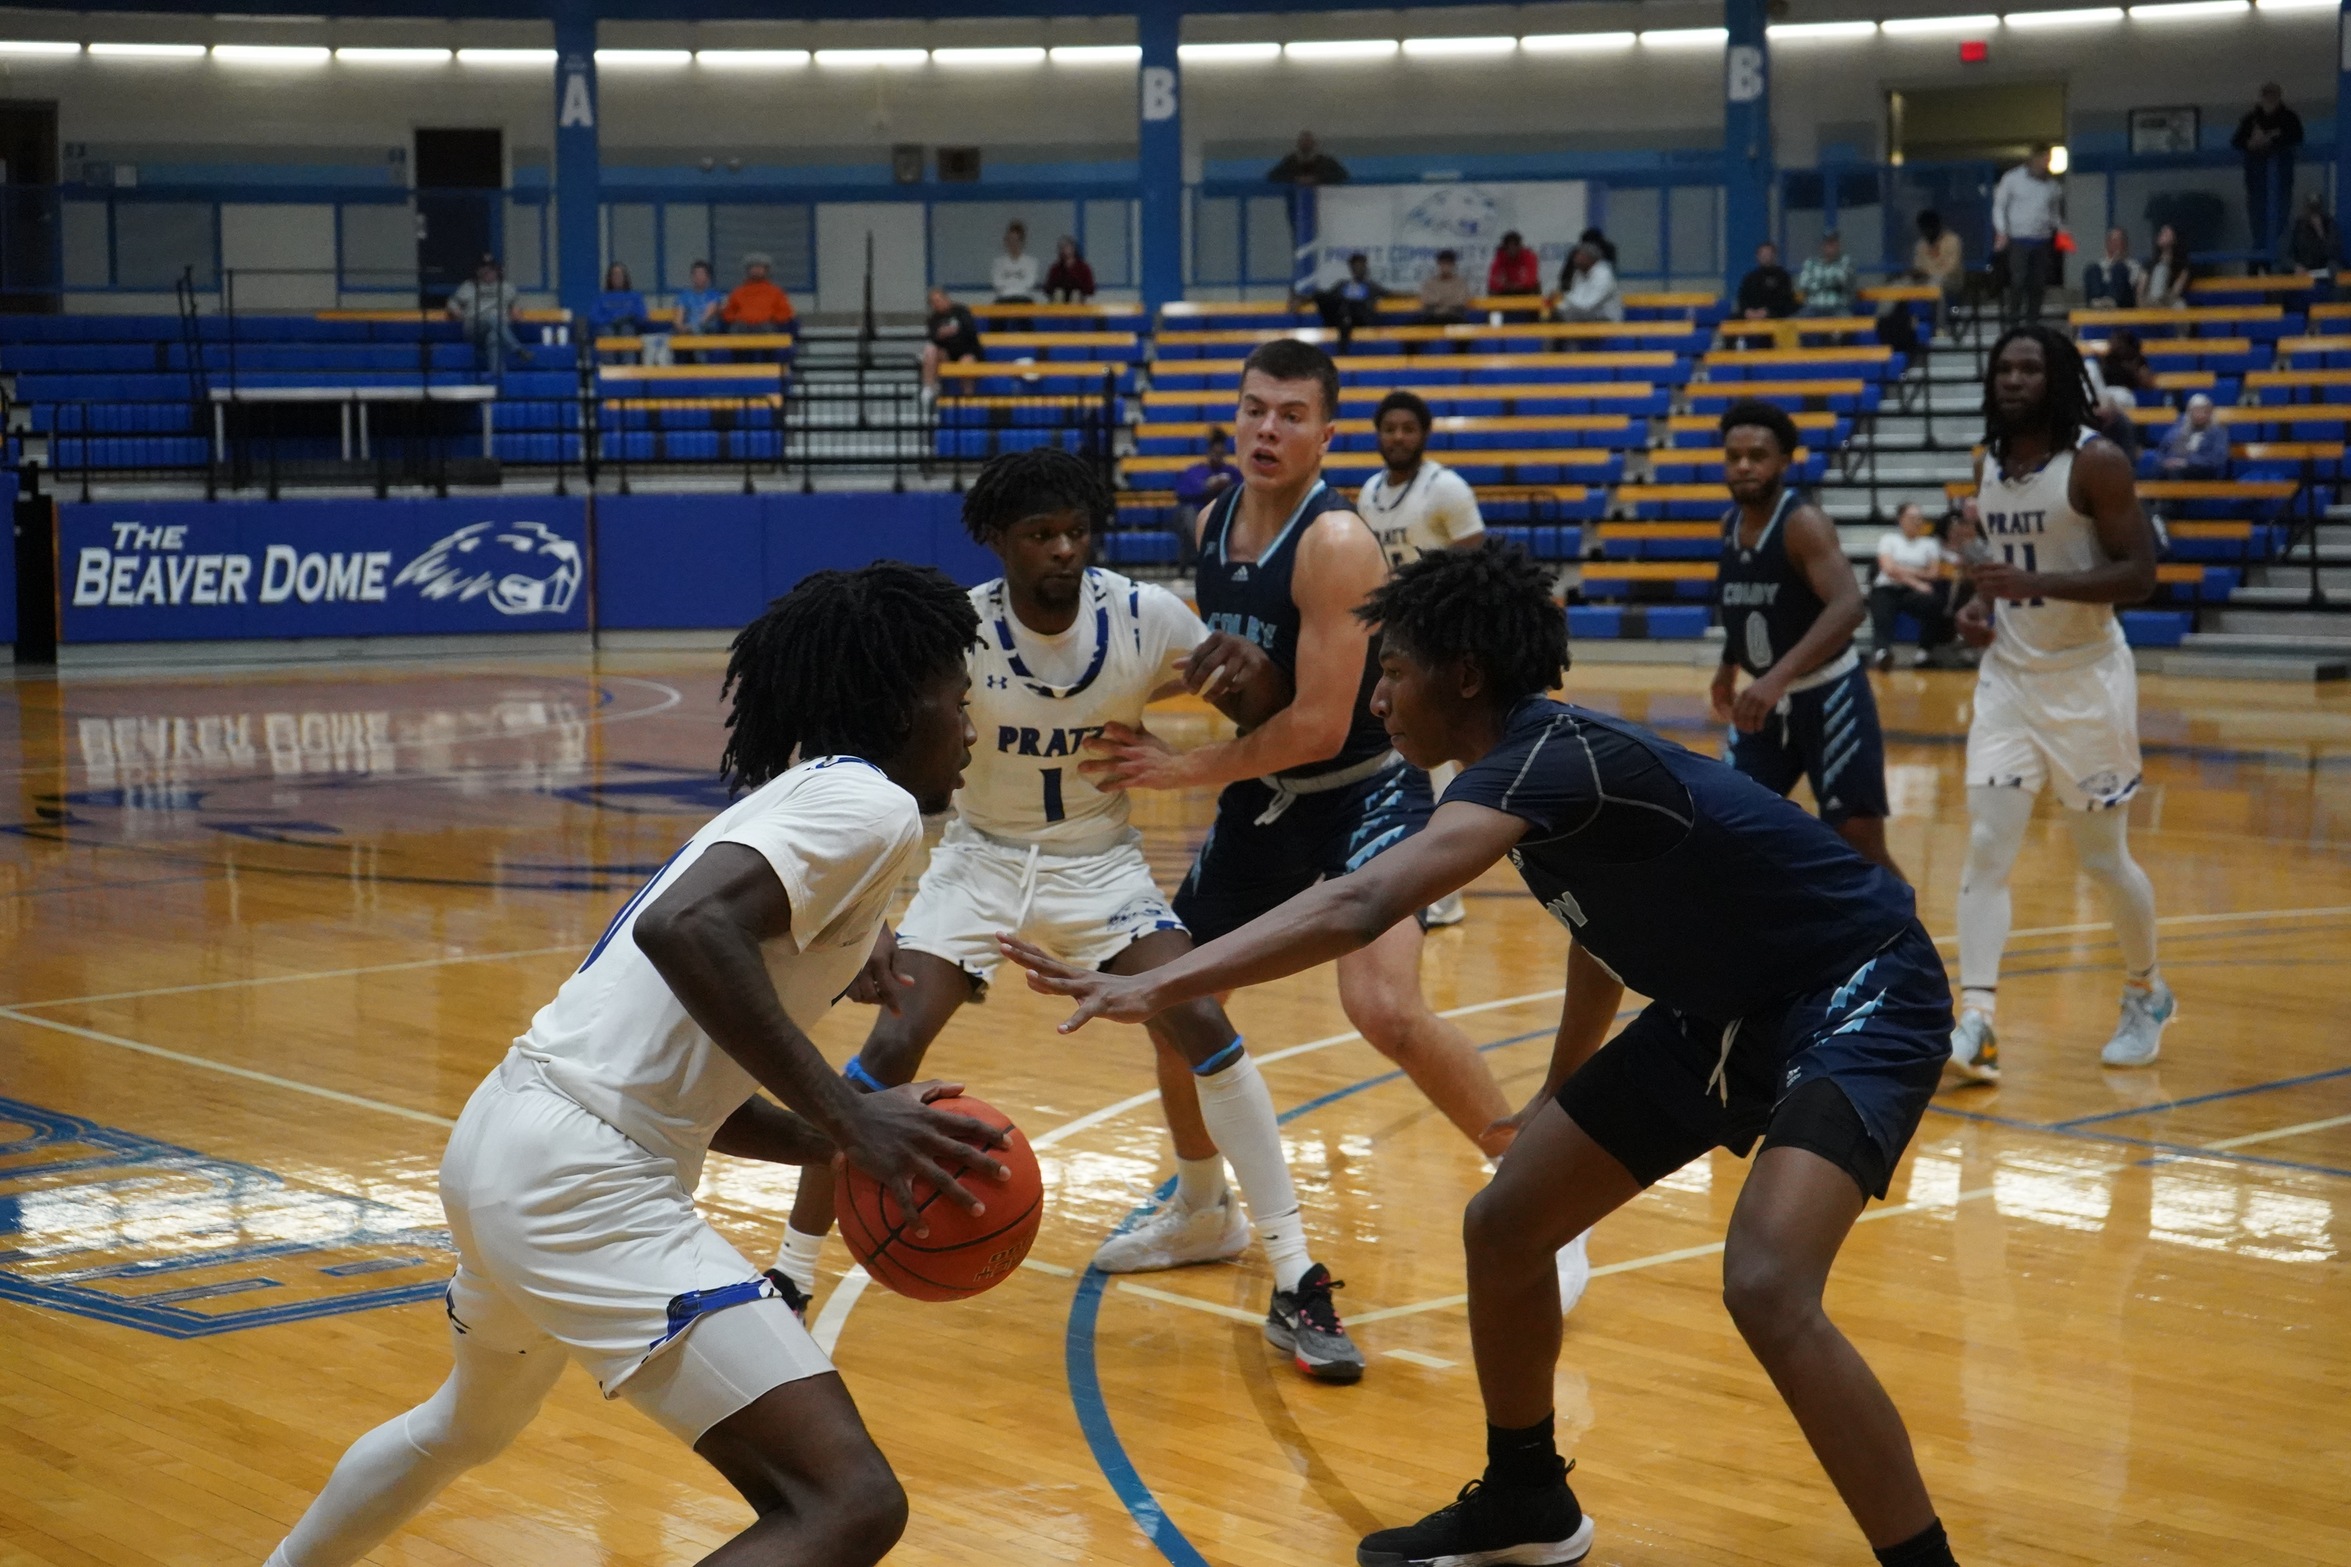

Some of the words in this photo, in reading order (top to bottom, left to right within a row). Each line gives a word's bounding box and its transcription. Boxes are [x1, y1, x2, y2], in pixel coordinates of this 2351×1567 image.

[1143, 67, 1177, 120] B
[1728, 47, 1763, 100] B
[560, 74, 594, 127] A
[112, 521, 188, 550] THE
[1987, 510, 2045, 534] PRATT
[73, 547, 251, 606] BEAVER
[259, 544, 391, 604] DOME
[1746, 610, 1773, 668] 0
[1038, 767, 1066, 822] 1
